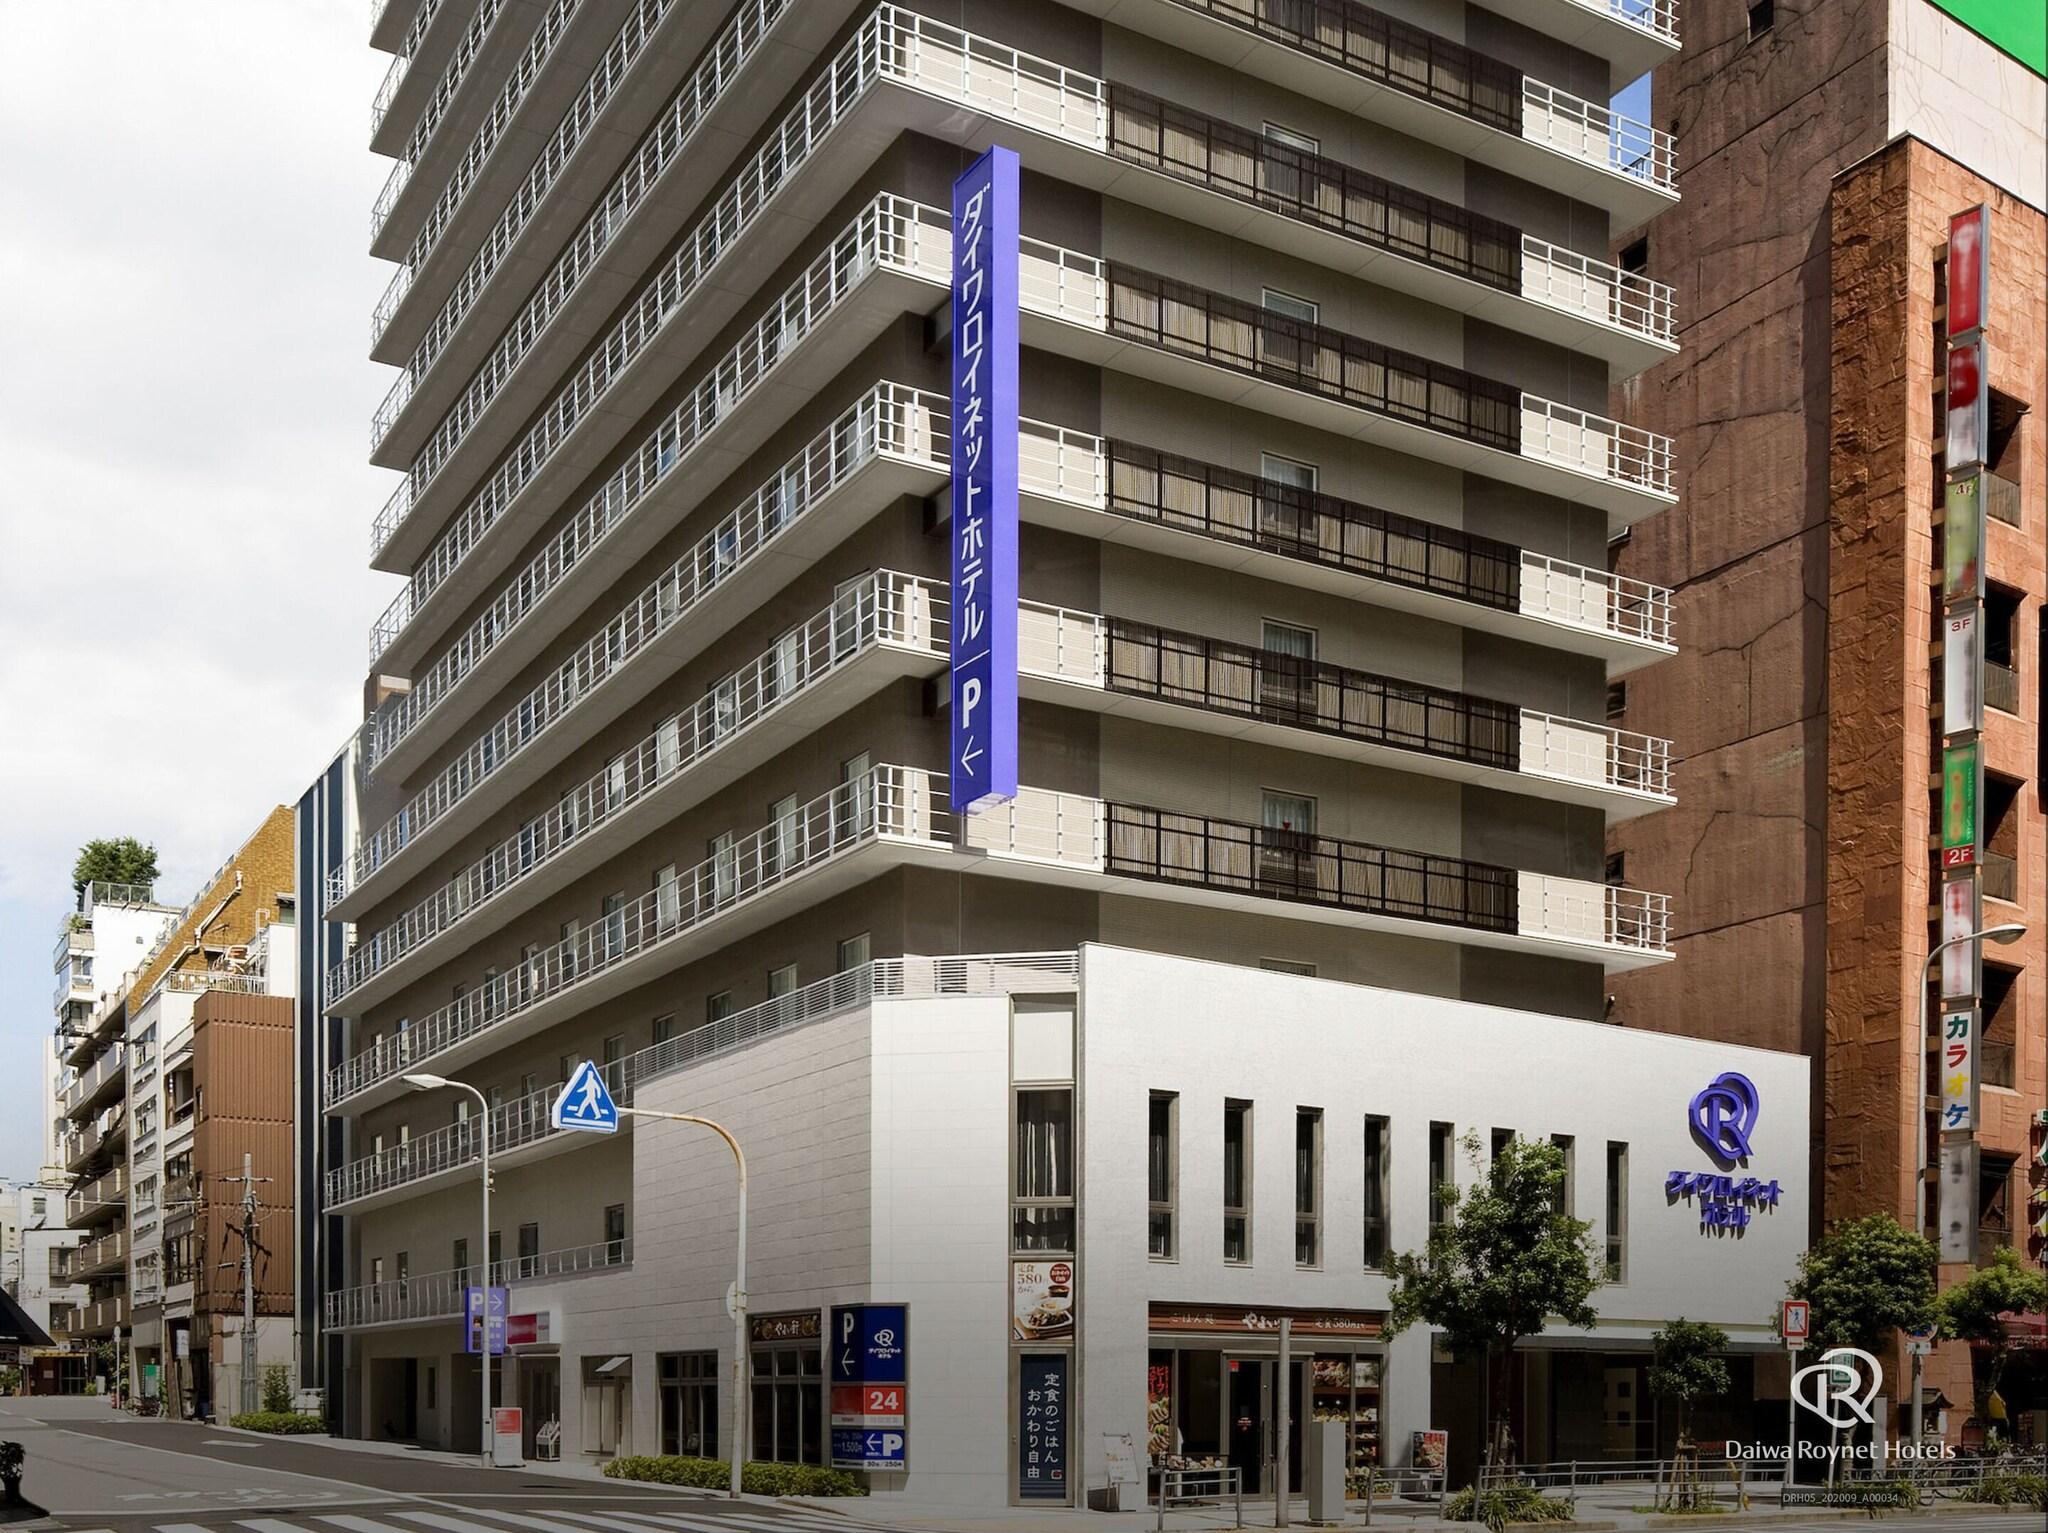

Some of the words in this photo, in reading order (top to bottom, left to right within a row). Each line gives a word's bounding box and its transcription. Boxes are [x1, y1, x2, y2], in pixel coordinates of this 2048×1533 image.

[961, 182, 991, 646] ダイワロイネットホテル
[1951, 618, 1971, 632] 3F
[962, 677, 982, 730] P
[1949, 849, 1969, 864] 2F
[1945, 1015, 1969, 1128] カラオケ
[471, 1293, 484, 1311] P
[843, 1312, 855, 1344] P
[869, 1391, 899, 1411] 24
[1026, 1389, 1042, 1479] おかわり自由
[1044, 1373, 1061, 1463] 定食のごはん
[882, 1433, 904, 1457] P
